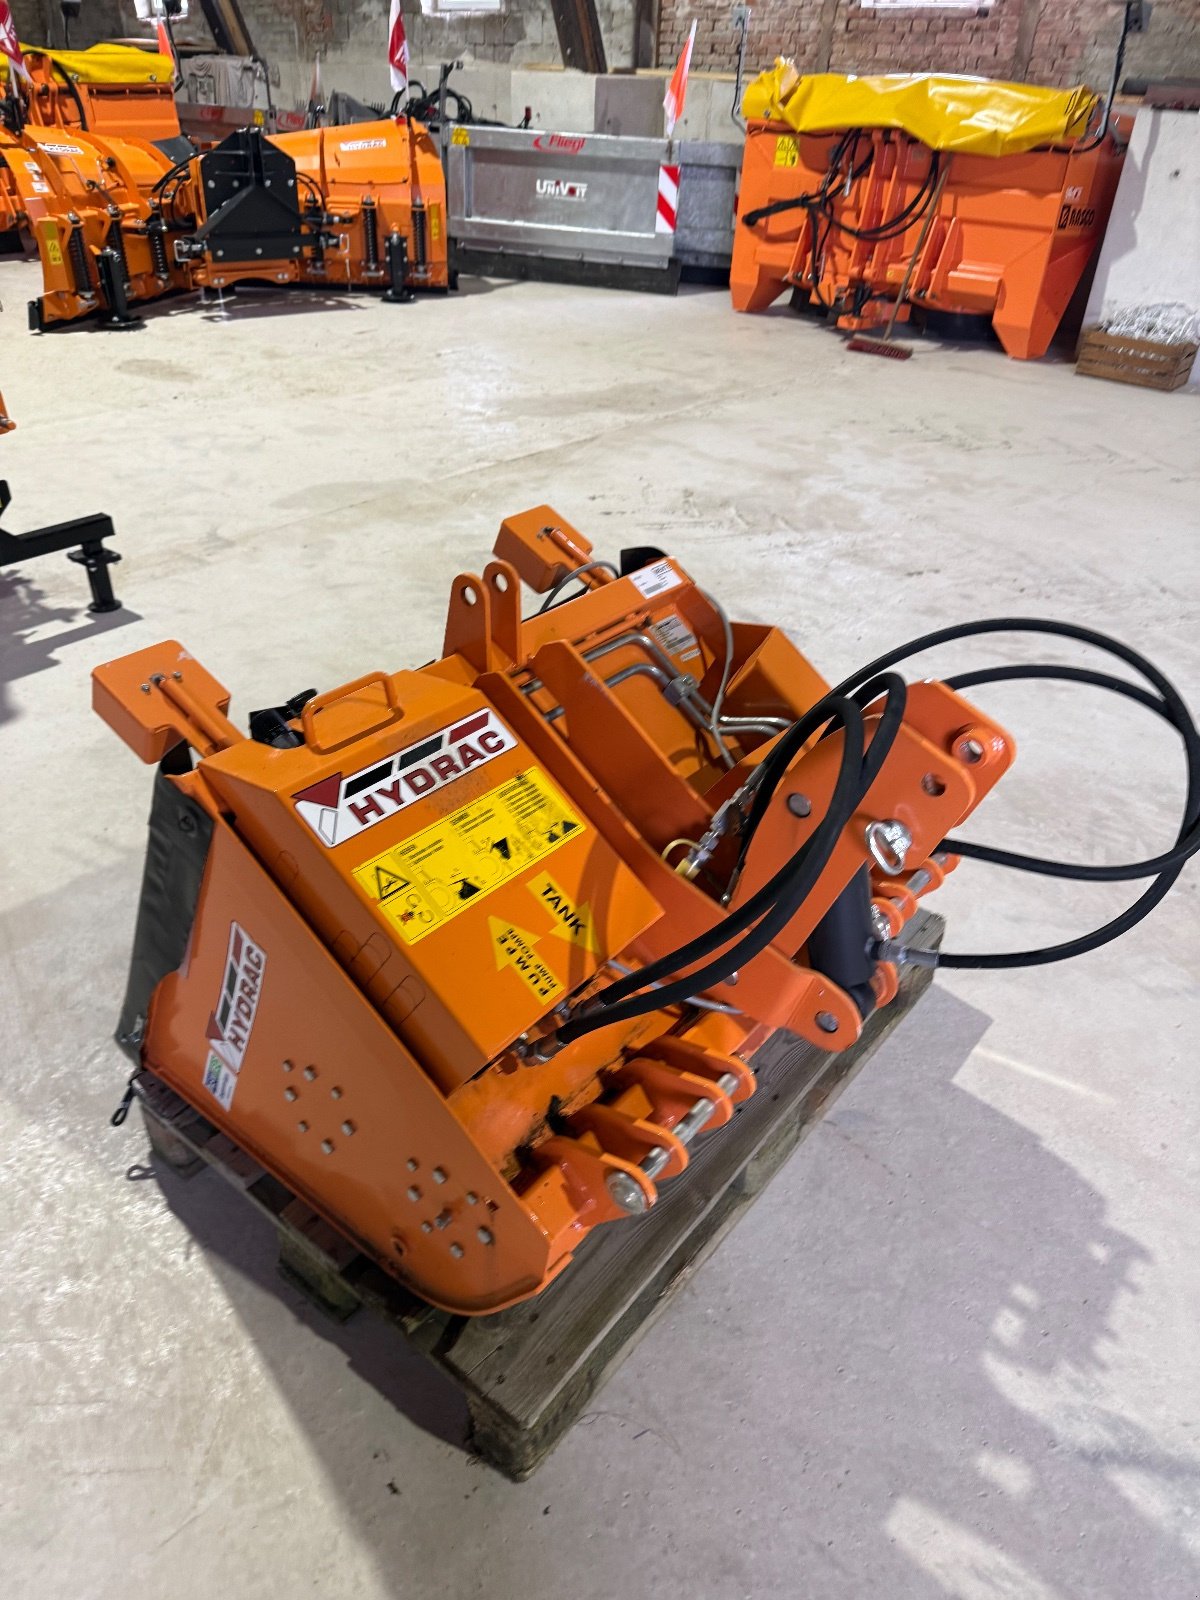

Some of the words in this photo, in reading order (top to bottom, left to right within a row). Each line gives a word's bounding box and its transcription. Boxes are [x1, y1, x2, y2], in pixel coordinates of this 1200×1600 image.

[548, 134, 586, 153] Fliegl
[346, 730, 506, 826] HYDRAC
[541, 882, 586, 936] TANK
[227, 945, 264, 1053] HYDRAC
